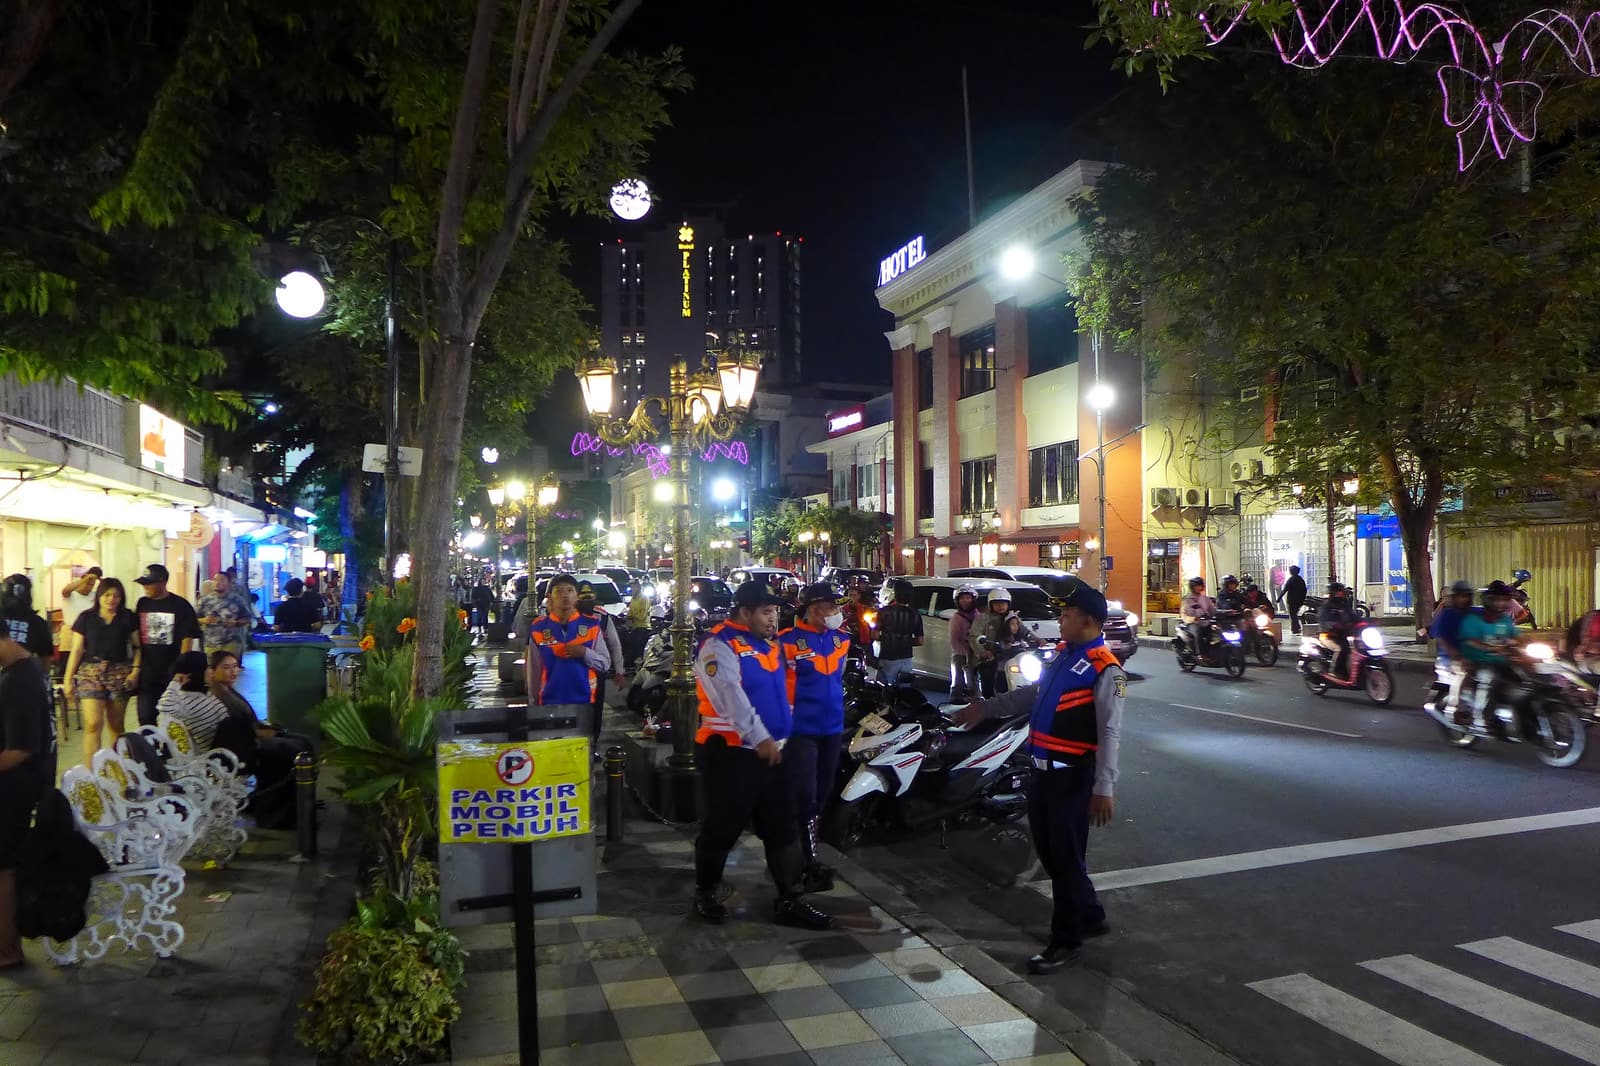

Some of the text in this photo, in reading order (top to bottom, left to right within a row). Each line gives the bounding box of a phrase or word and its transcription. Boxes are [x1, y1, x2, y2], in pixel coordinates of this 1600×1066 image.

[878, 235, 927, 286] HOTEL
[681, 251, 691, 318] PLATINUM
[452, 784, 577, 803] PARKIR
[451, 801, 578, 819] MOBIL
[452, 816, 578, 838] PENUH
